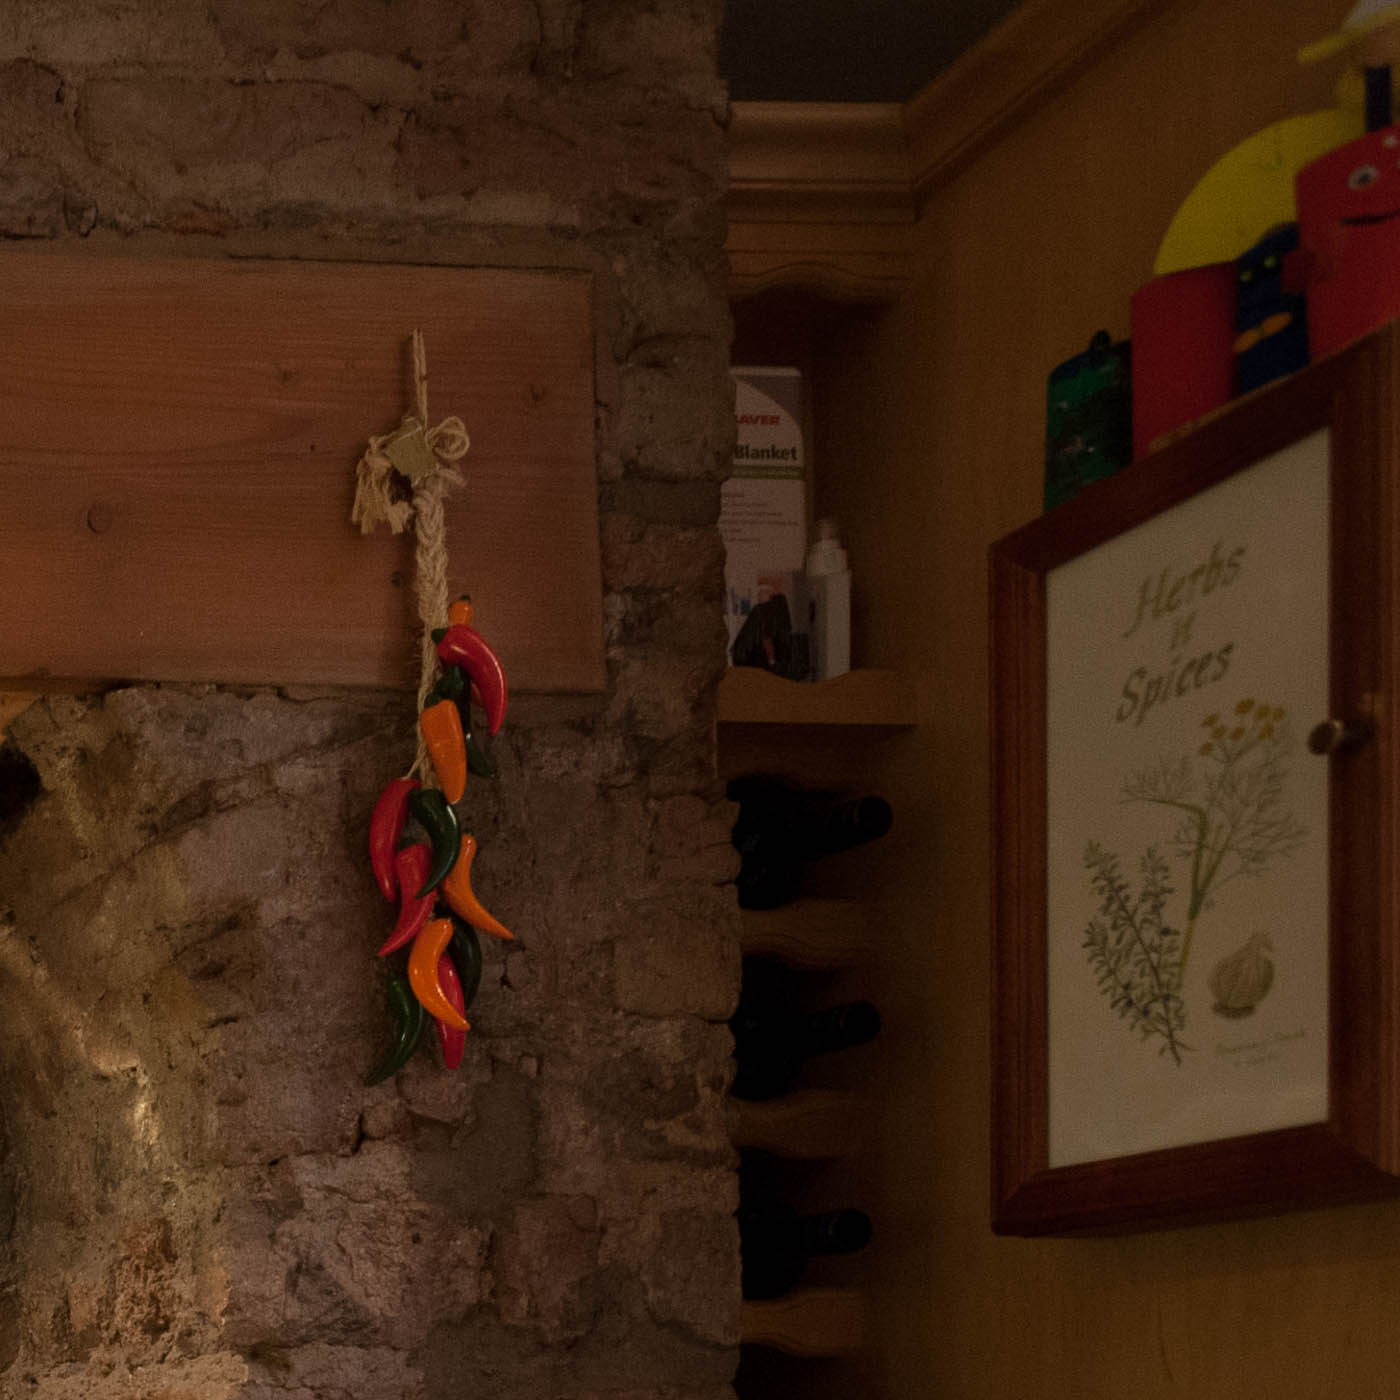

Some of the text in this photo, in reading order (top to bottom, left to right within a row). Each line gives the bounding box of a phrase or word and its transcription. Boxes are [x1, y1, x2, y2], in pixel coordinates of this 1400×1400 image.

[734, 444, 798, 461] Blanket
[1122, 540, 1246, 640] Herbs
[1115, 642, 1235, 726] Spices
